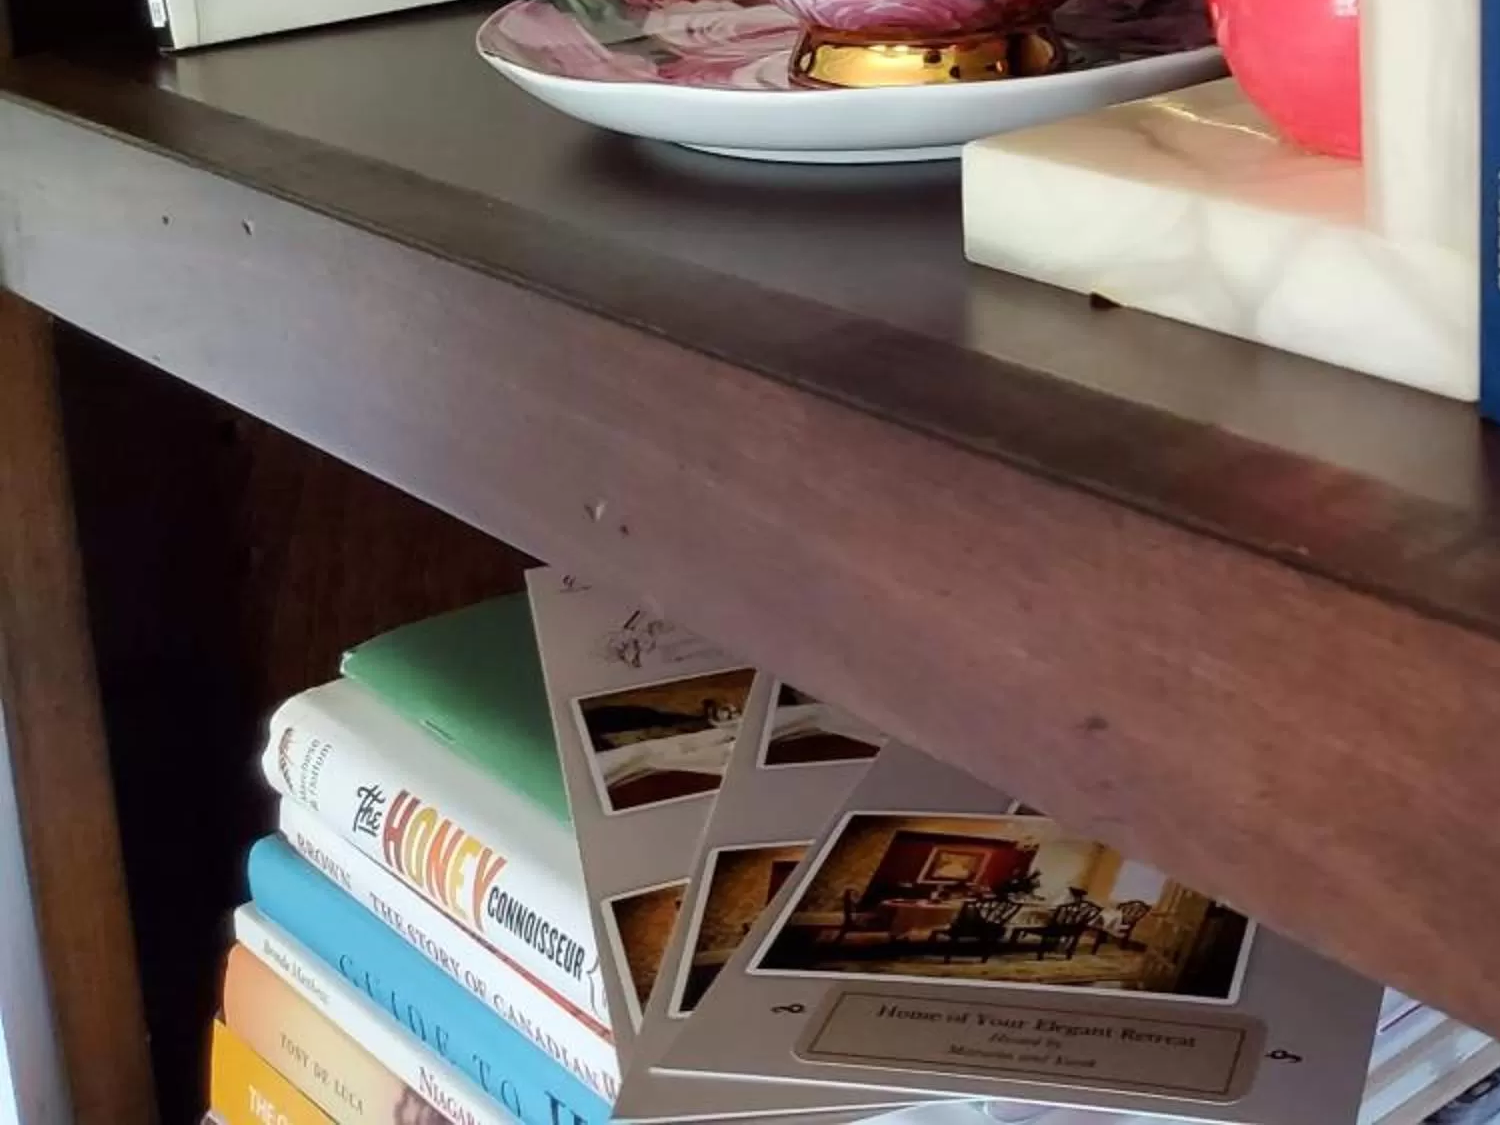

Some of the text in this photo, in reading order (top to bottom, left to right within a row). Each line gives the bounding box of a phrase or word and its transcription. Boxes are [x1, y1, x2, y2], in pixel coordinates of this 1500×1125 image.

[297, 832, 352, 892] BROWN
[369, 891, 405, 934] THE
[407, 923, 461, 978] STORY
[464, 970, 488, 998] OF
[493, 993, 600, 1092] CANADIAN
[382, 789, 508, 933] HONEY
[487, 885, 586, 981] CONNOISSEUR
[877, 1004, 1196, 1048] Home of Your Elegant Retreat
